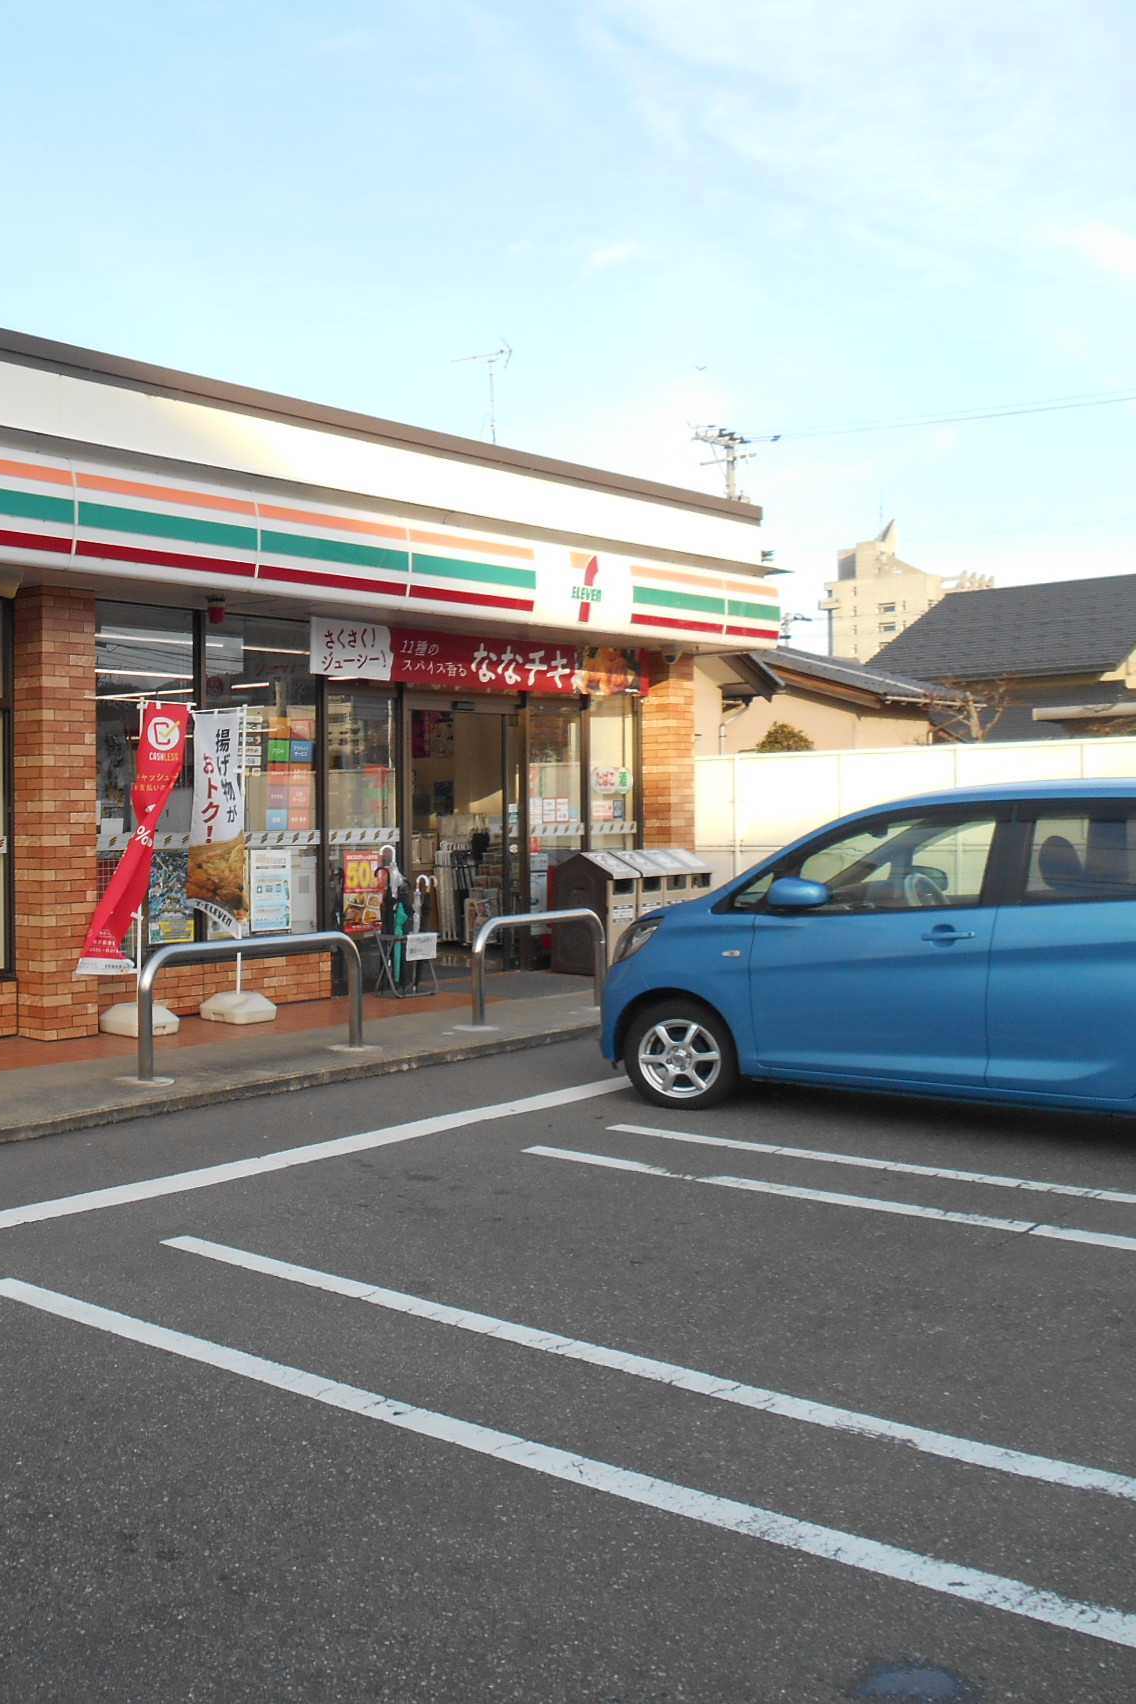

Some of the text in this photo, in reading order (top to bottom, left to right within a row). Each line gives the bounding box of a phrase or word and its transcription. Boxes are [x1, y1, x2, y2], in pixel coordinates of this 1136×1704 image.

[400, 639, 440, 656] 11種の
[401, 660, 467, 677] スパイス香る
[149, 751, 179, 762] CASHLESS
[216, 728, 238, 823] 揚げ物が
[201, 752, 220, 844] おトク!
